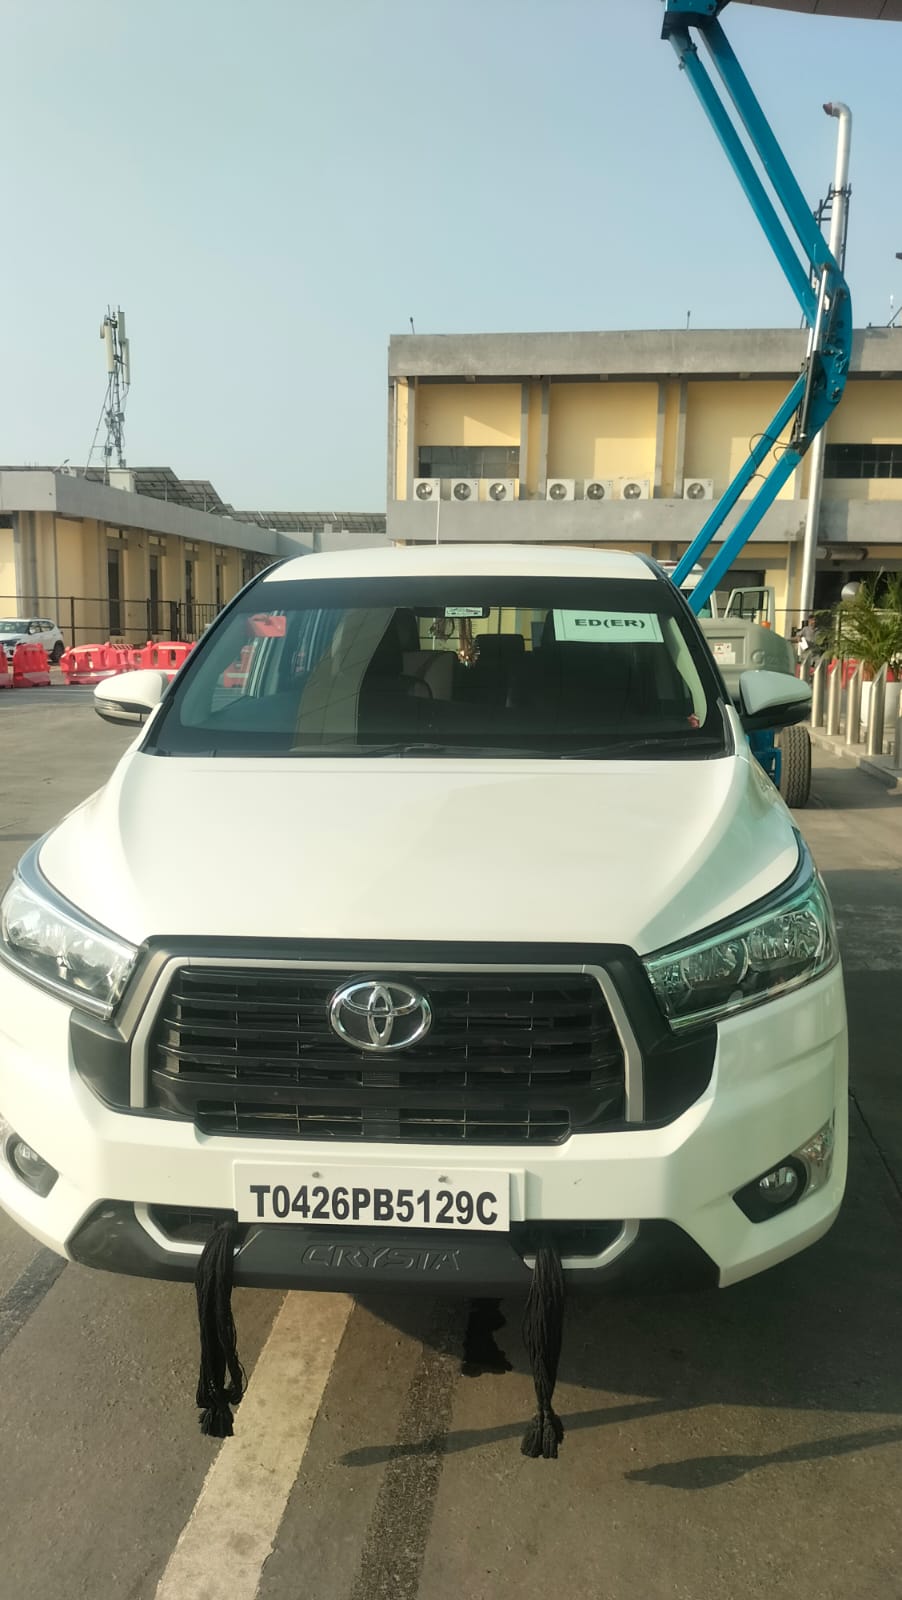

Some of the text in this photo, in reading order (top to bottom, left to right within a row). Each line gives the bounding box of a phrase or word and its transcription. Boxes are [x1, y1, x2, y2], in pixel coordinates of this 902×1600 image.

[574, 618, 646, 628] ED(ER)
[249, 1184, 499, 1226] T0426PB5129C
[301, 1243, 461, 1271] CRYSTA
